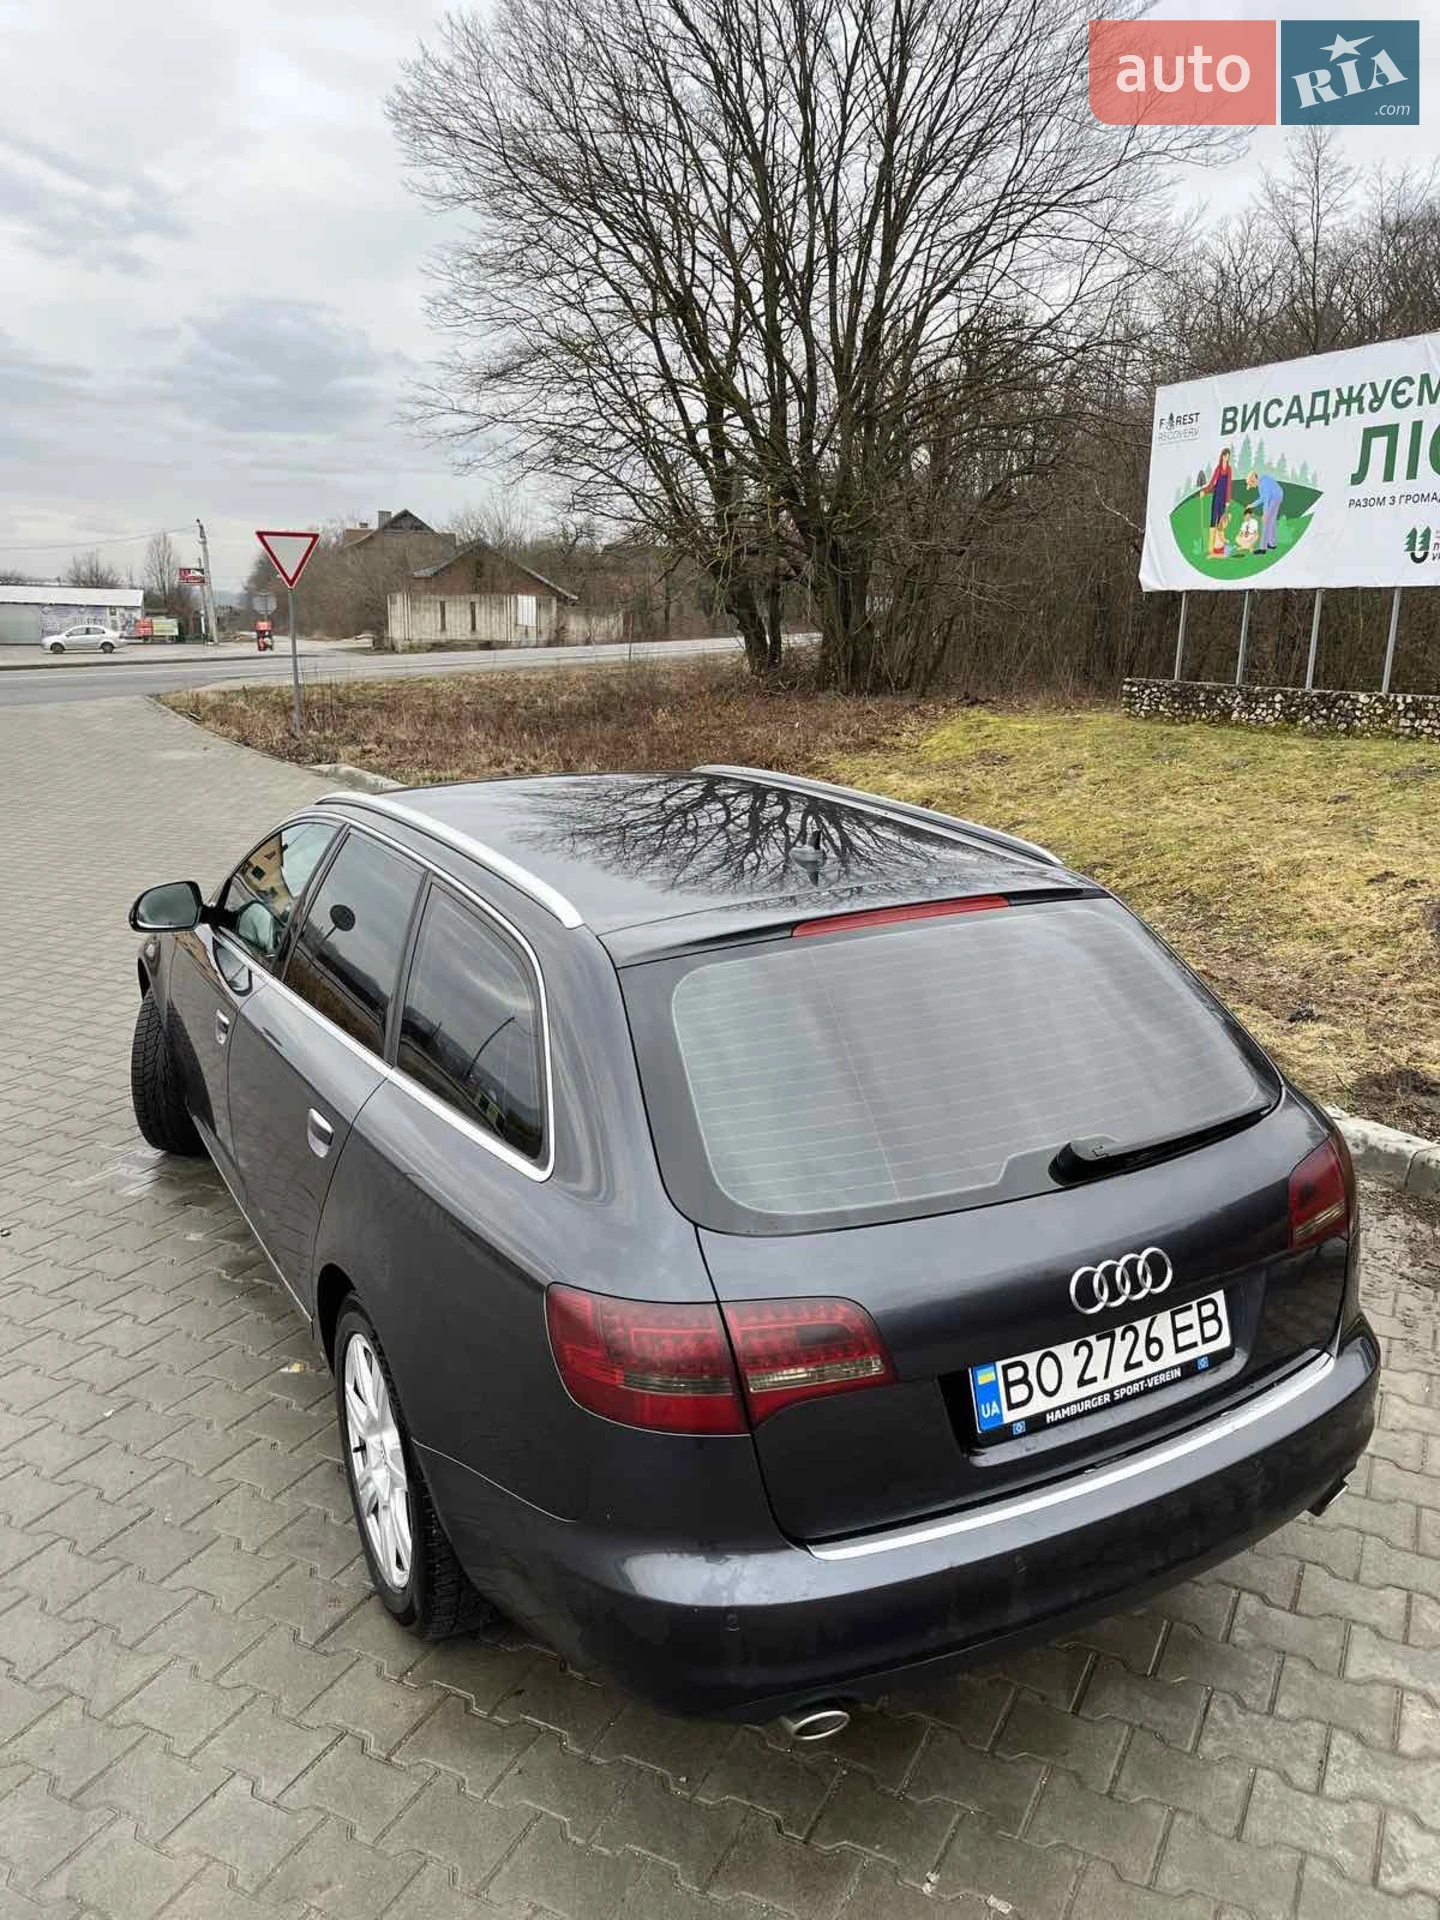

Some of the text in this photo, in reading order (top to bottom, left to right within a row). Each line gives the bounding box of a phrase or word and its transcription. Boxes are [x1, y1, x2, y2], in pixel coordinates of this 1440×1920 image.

[1220, 372, 1440, 436] ВИСАДЖУЄМ
[1350, 420, 1440, 486] ЛІ
[1348, 495, 1386, 508] РАЗОМ
[1398, 491, 1440, 504] ГРОМА
[1001, 1297, 1223, 1411] BO 2726 EB
[981, 1402, 1000, 1418] UA
[1046, 1367, 1181, 1424] HAMBURGER SPORT-VEREIN
